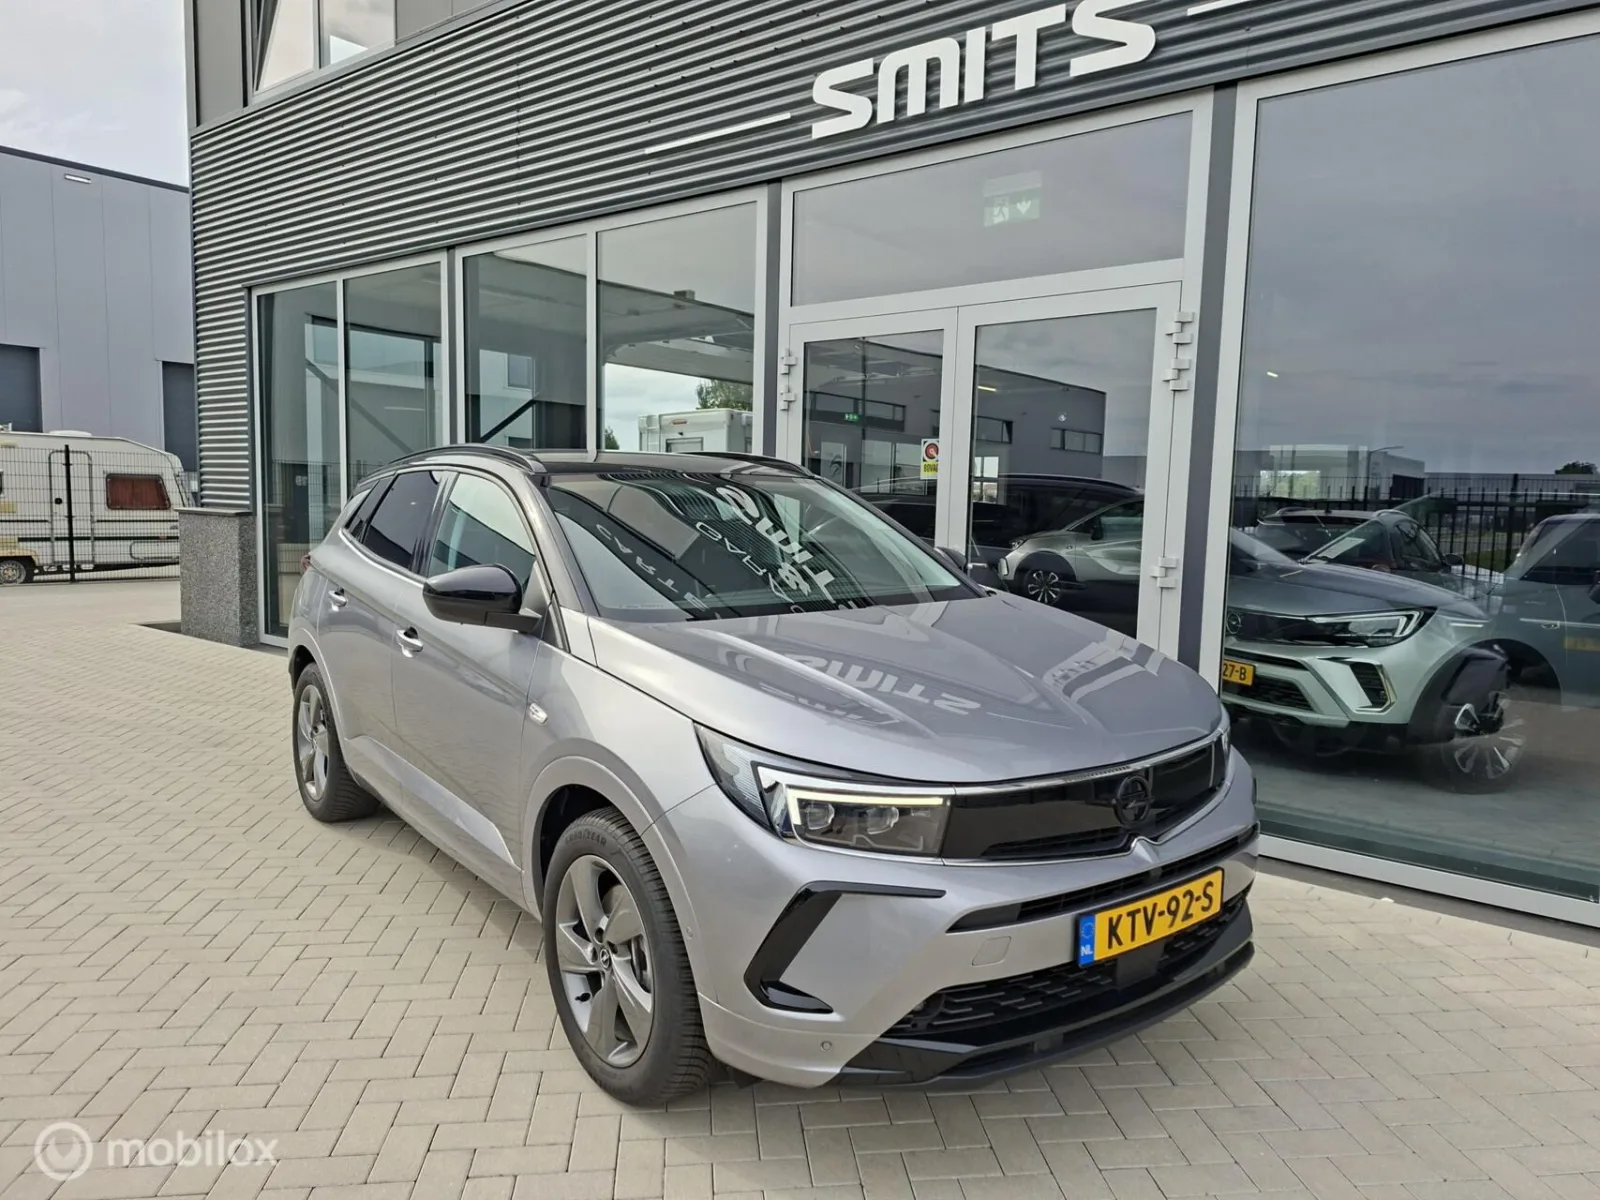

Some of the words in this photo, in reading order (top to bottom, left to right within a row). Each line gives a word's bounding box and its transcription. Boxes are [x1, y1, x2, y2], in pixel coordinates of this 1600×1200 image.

[811, 0, 1157, 139] SMITS
[1107, 880, 1214, 950] KTV-92-S
[1080, 944, 1093, 957] NL
